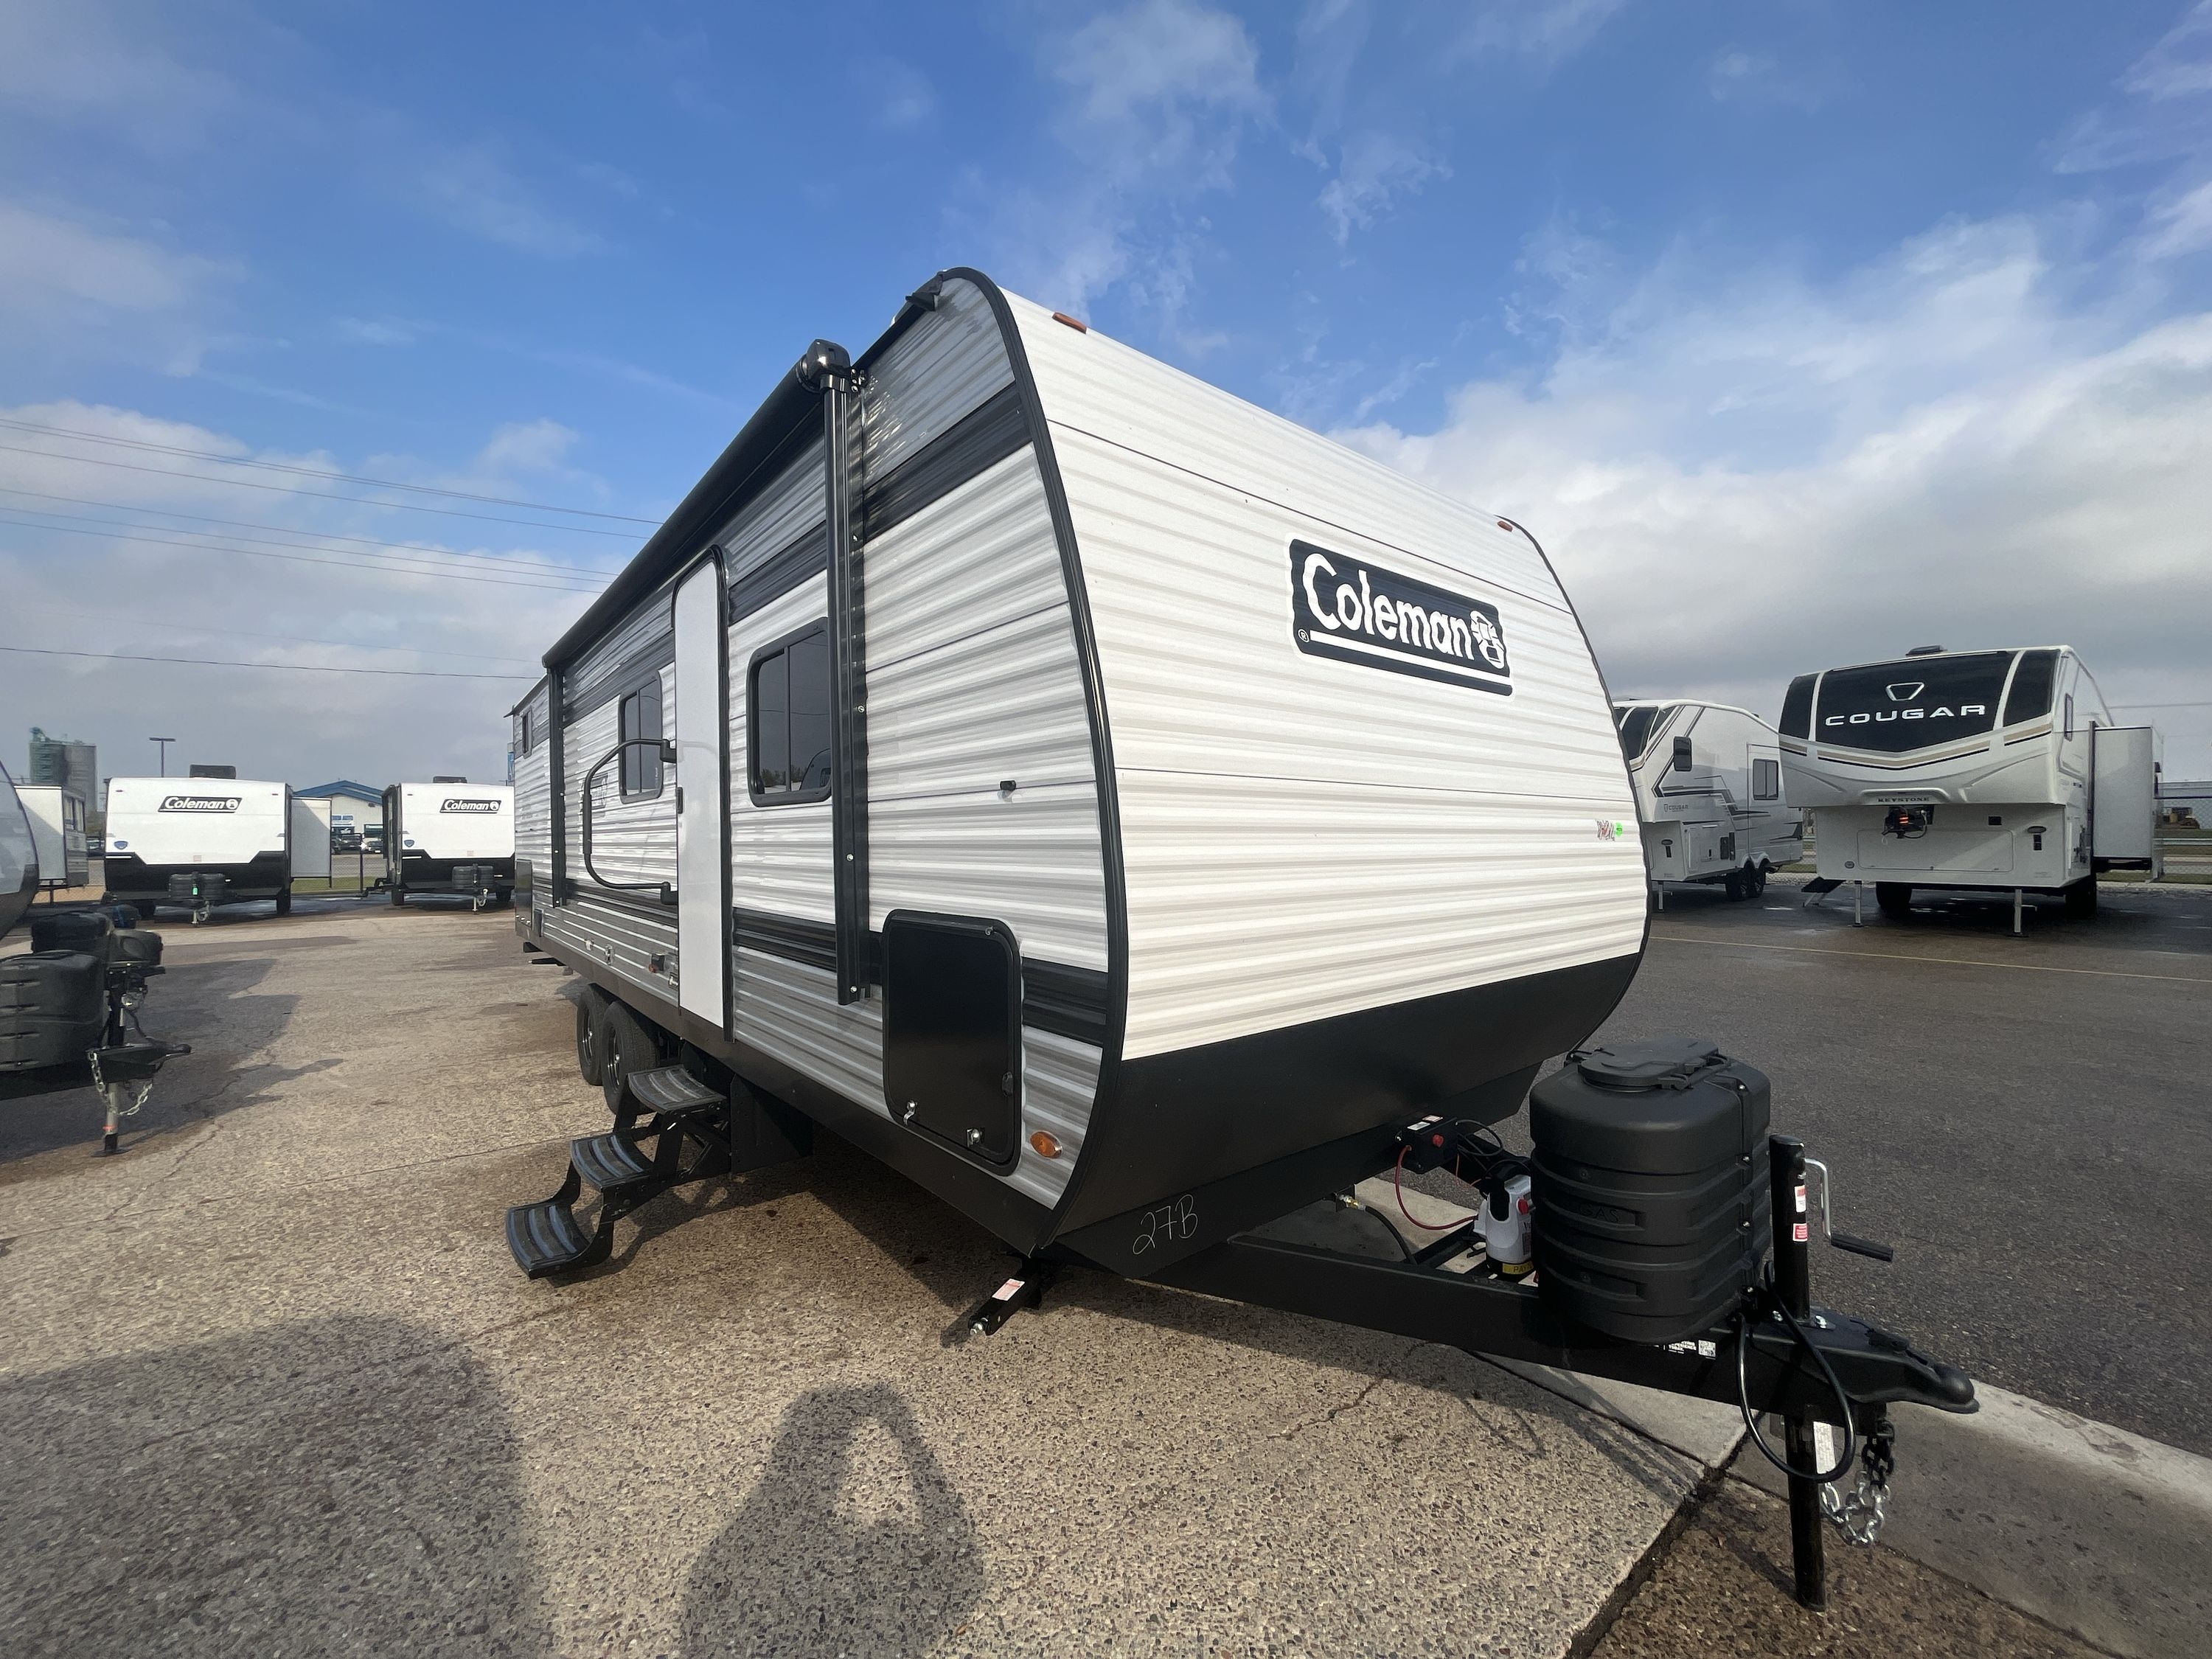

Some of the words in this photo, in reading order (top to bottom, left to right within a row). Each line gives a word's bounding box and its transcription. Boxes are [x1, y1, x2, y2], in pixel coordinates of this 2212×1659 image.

[1302, 553, 1475, 661] Coleman
[1825, 705, 1986, 726] COUGAR
[164, 796, 225, 809] Coleman
[444, 799, 490, 810] Coleman
[1133, 1194, 1198, 1255] 27B
